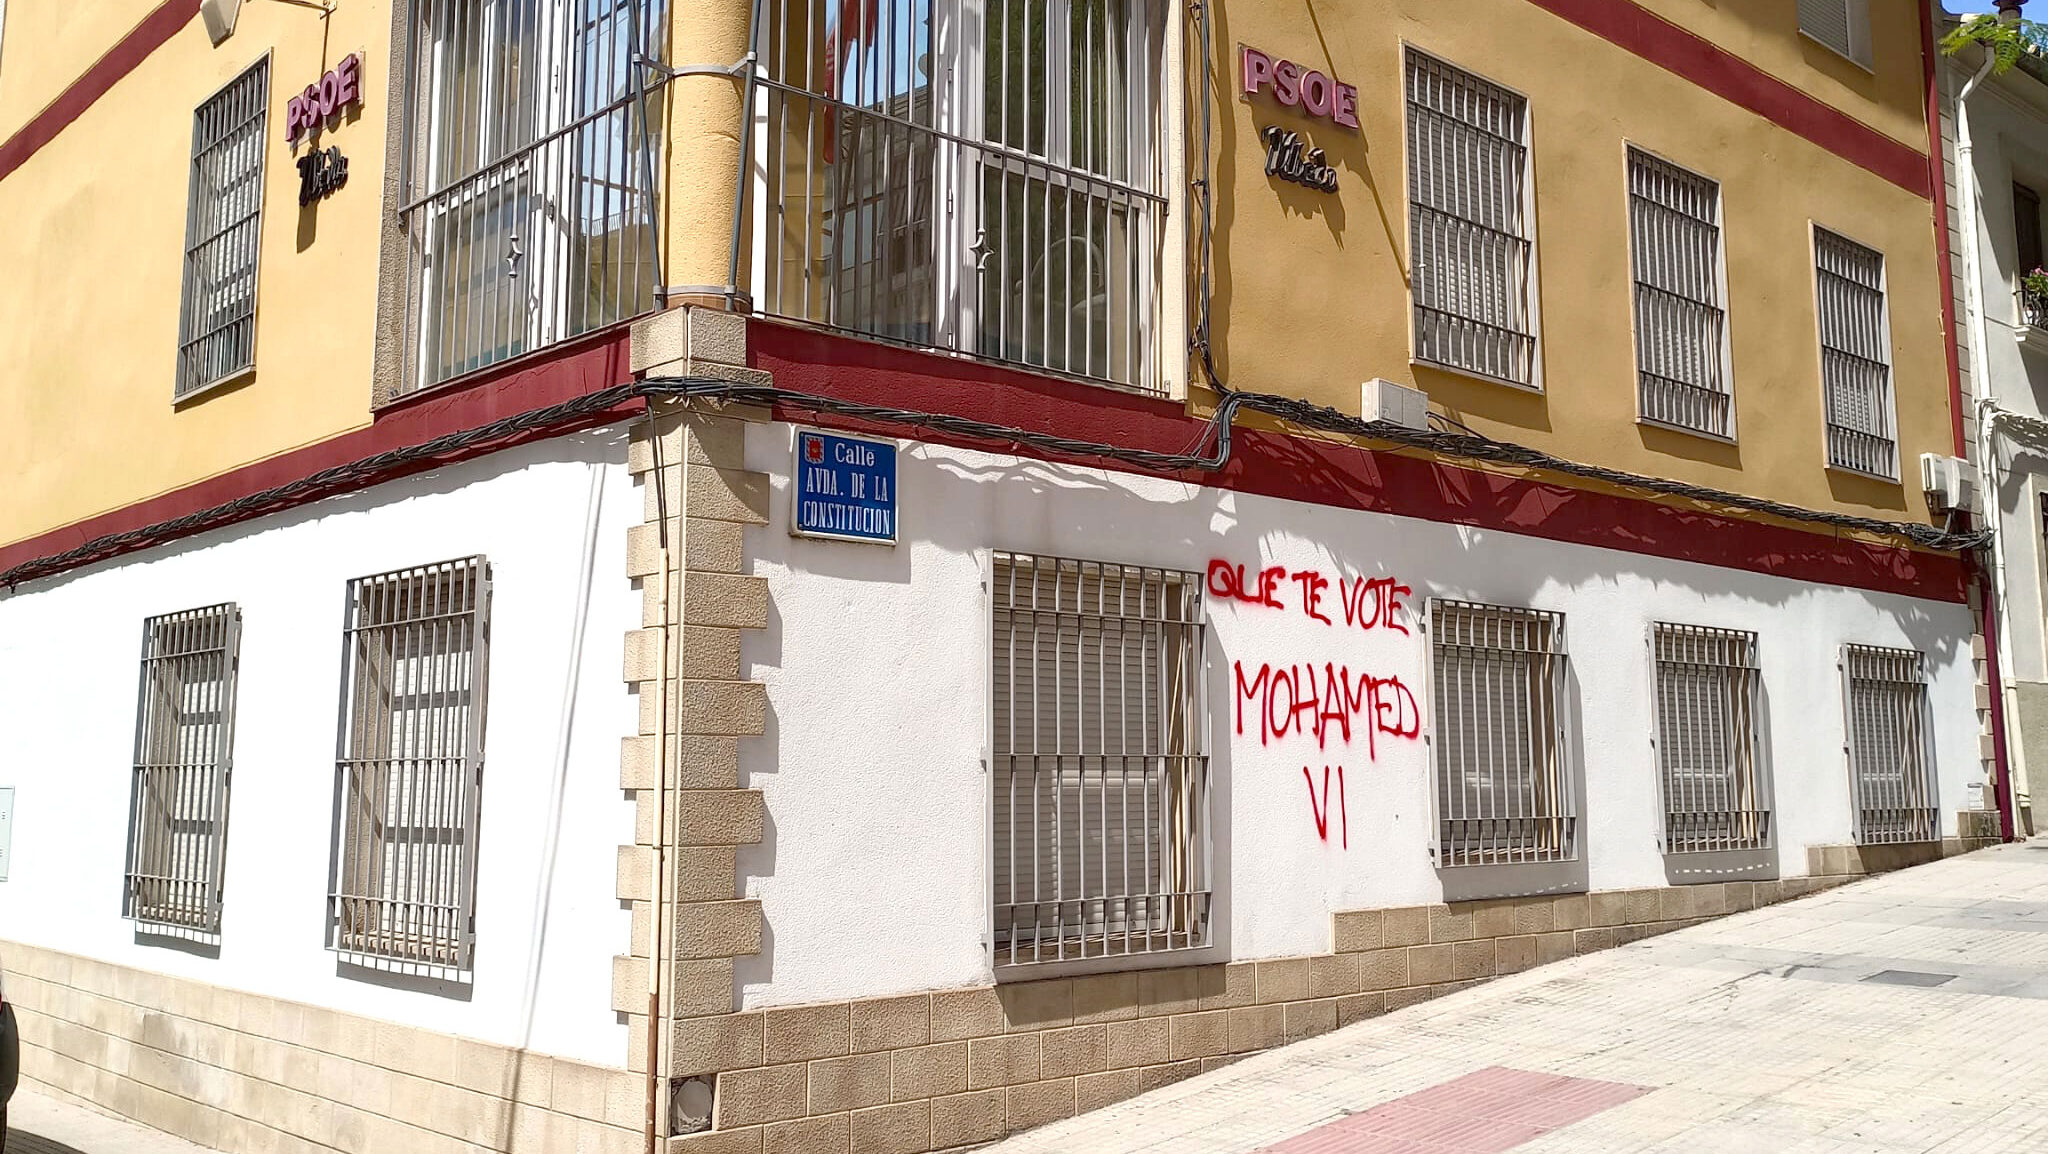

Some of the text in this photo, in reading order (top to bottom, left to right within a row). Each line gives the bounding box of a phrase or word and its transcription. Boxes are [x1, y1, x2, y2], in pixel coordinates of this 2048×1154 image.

[285, 53, 359, 142] PSOE
[1244, 48, 1358, 129] PSOE
[806, 466, 888, 502] AVDA. DE LA
[835, 442, 875, 467] Calle
[803, 501, 890, 534] CONSTITUCION
[1207, 558, 1412, 637] QUE TE VOTE
[1234, 659, 1420, 763] MOHAMED
[1303, 765, 1347, 851] VI
